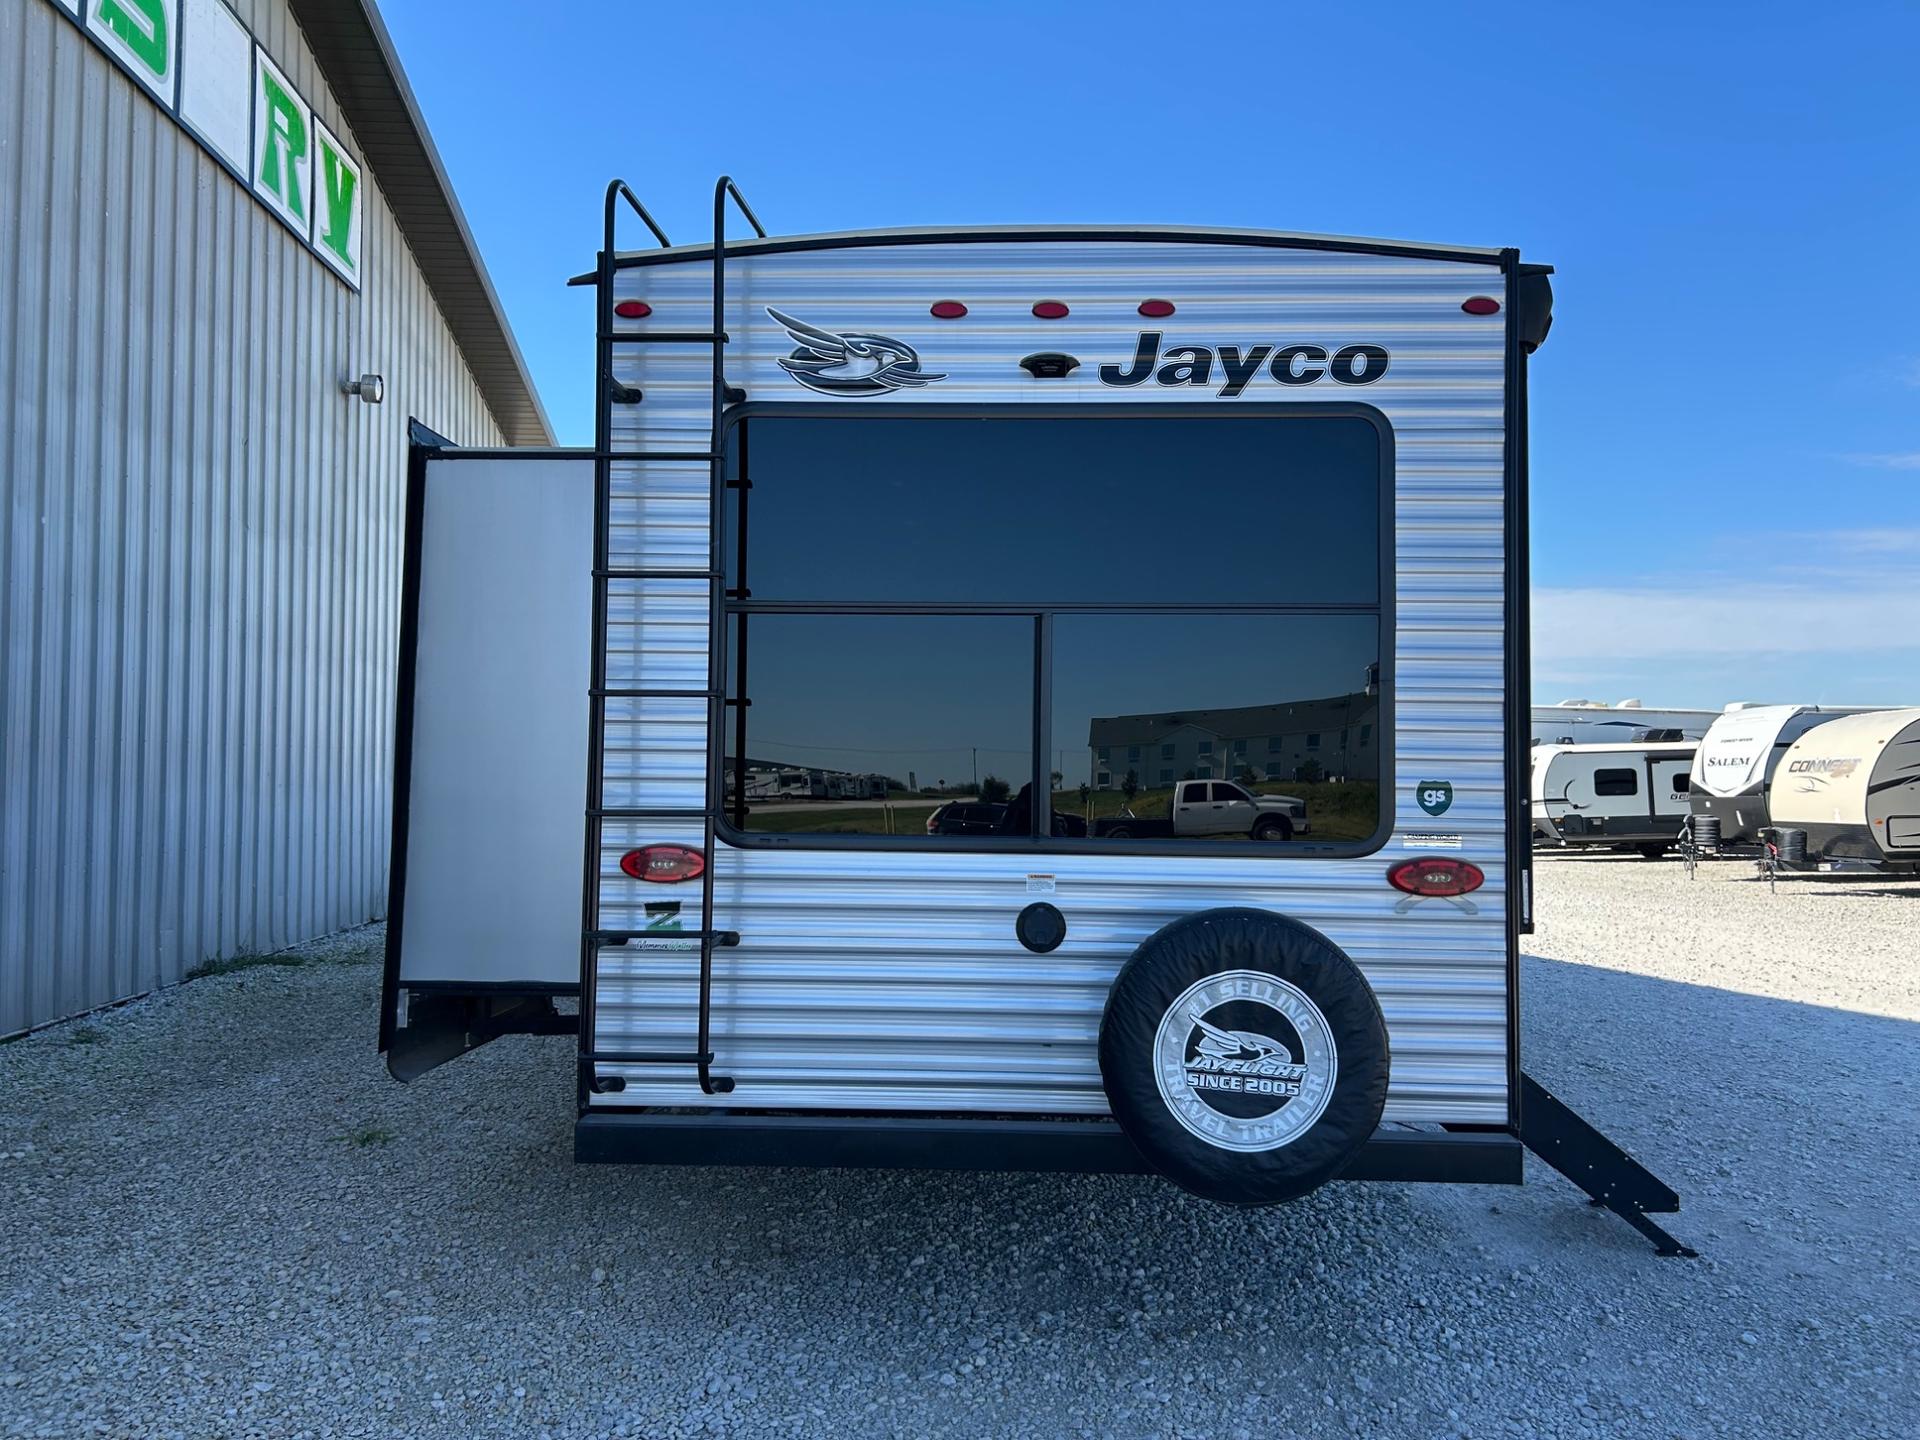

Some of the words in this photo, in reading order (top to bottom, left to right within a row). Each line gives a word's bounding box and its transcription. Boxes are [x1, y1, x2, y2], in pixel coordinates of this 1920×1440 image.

[258, 66, 359, 275] RV
[1098, 331, 1390, 400] Jayco
[1423, 789, 1446, 807] gs
[1218, 980, 1315, 1033] SELLING
[1165, 1058, 1232, 1138] TRAVEL
[1236, 1073, 1327, 1142] TRAILER
[1186, 1073, 1242, 1091] SINCE
[1244, 1078, 1301, 1097] 2005
